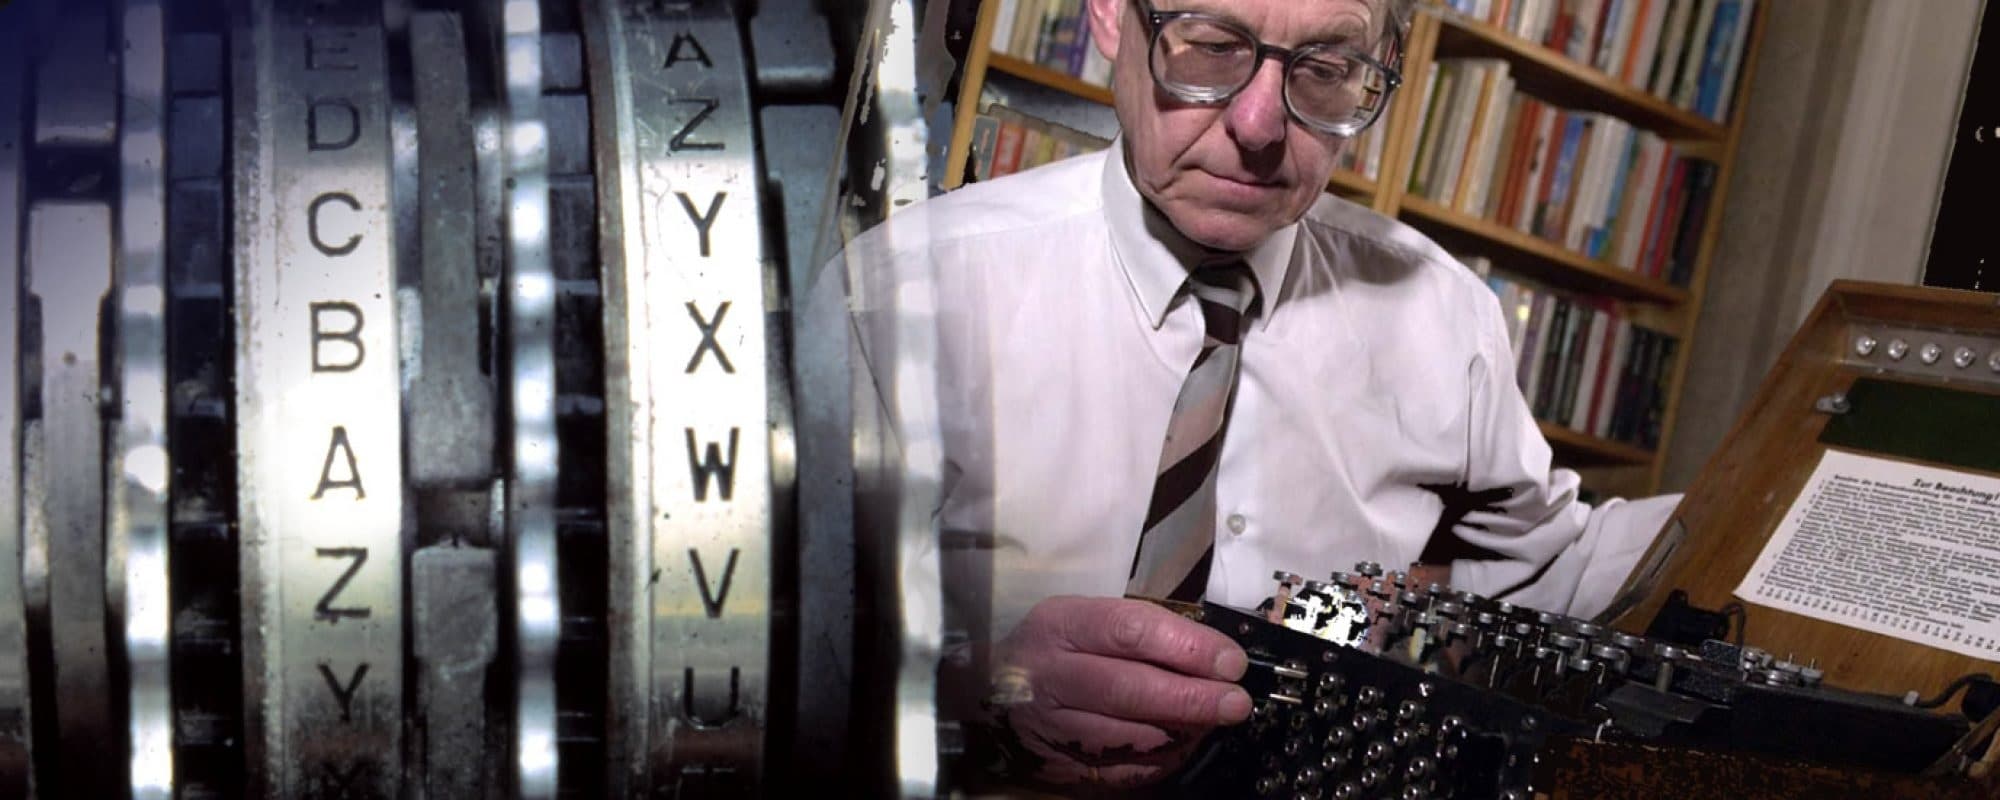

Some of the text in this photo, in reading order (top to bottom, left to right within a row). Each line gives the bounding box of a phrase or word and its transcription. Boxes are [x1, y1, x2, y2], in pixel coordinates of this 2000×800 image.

[664, 32, 713, 69] A
[307, 103, 361, 151] D
[667, 98, 726, 151] Z
[307, 191, 363, 257] C
[674, 191, 727, 257] Y
[310, 301, 365, 373] B
[685, 301, 735, 374] X
[311, 426, 366, 500] A
[685, 427, 740, 502] W
[315, 547, 371, 621] Z
[688, 548, 741, 619] V
[318, 663, 369, 721] Y
[683, 666, 741, 730] U
